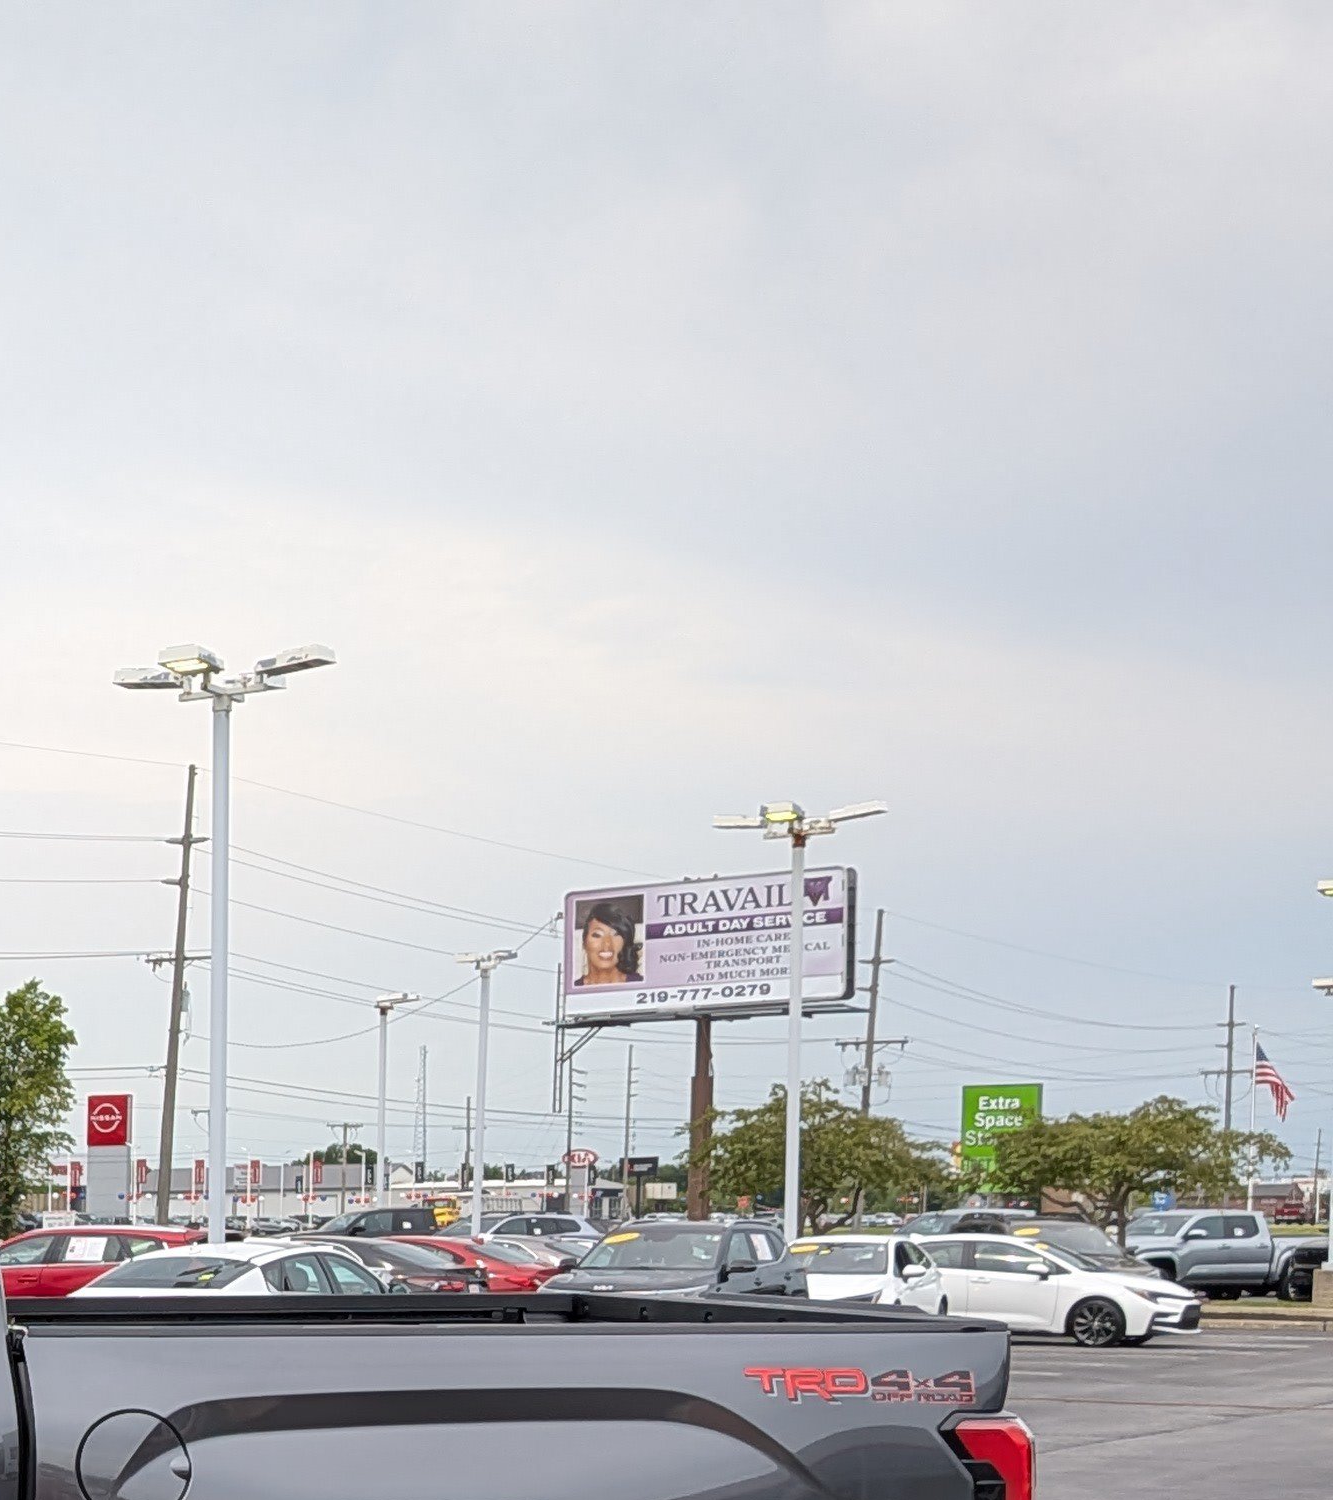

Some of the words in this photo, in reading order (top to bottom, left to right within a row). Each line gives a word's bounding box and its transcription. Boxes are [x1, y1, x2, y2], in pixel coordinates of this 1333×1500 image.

[663, 921, 713, 936] ADULT
[719, 917, 751, 932] DAY
[696, 934, 753, 948] IN-HOME
[756, 932, 791, 943] CARE
[659, 946, 770, 963] NON-EMERGENCY
[772, 941, 831, 955] MECAL
[705, 955, 782, 969] TRANSPORT
[687, 971, 714, 983] AND
[718, 969, 756, 980] MUCH
[759, 966, 791, 977] MOR
[636, 983, 771, 1005] 219-777-0279
[978, 1096, 1021, 1110] Extra
[974, 1112, 1023, 1130] Space
[743, 1367, 871, 1404] TRD
[871, 1392, 913, 1402] OFF
[917, 1392, 975, 1404] ROAD
